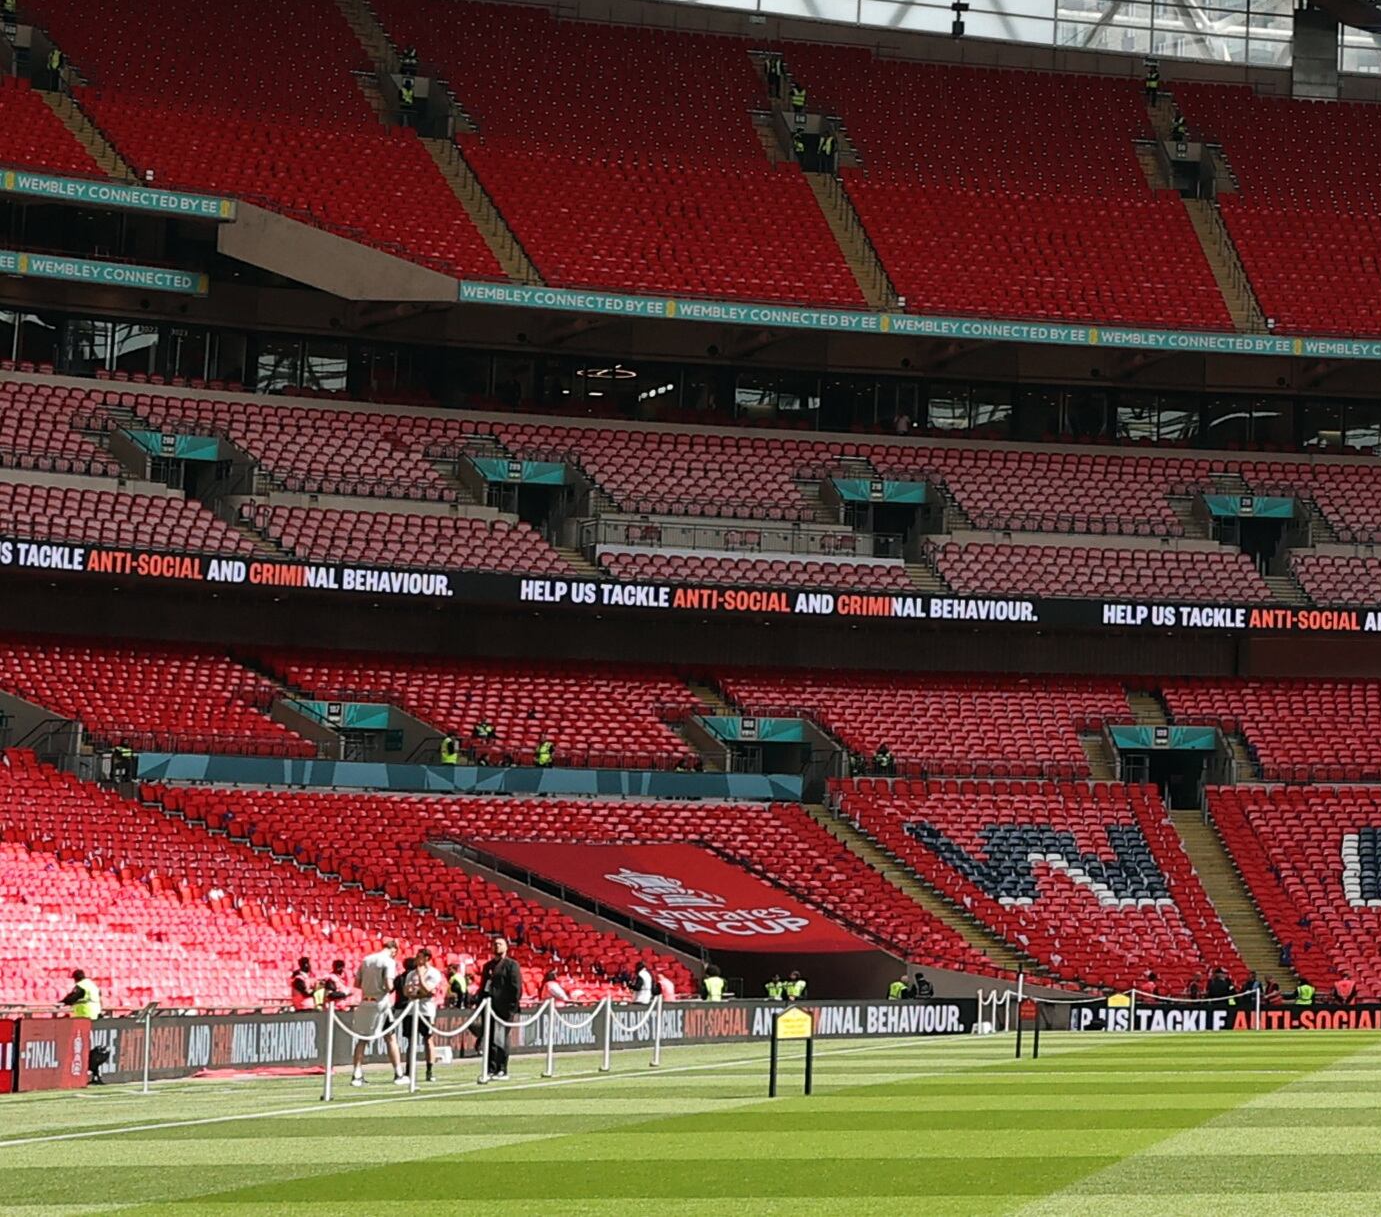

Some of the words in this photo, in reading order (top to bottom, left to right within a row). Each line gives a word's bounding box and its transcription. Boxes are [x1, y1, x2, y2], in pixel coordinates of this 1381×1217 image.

[19, 177, 85, 196] WEMBLEY
[89, 187, 177, 208] CONNECTED
[181, 198, 198, 211] BY
[202, 200, 217, 214] EE
[32, 260, 100, 278] WEMBLEY
[104, 267, 191, 287] CONNECTED
[463, 286, 531, 302] WEMBLEY
[535, 293, 623, 310] CONNECTED
[626, 300, 644, 312] BY
[647, 301, 662, 314] EE
[680, 304, 746, 320] WEMBLEY
[751, 309, 838, 326] CONNECTED
[841, 315, 858, 327] BY
[862, 317, 876, 329] EE
[893, 319, 958, 333] WEMBLEY
[962, 323, 1047, 339] CONNECTED
[1050, 329, 1067, 340] BY
[1071, 329, 1085, 341] EE
[17, 543, 84, 570] TACKLE
[88, 550, 202, 578] ANTI-SOCIAL
[207, 559, 245, 583] AND
[250, 562, 338, 589] CRIMINAL
[343, 569, 452, 596] BEHAVIOUR.
[521, 580, 567, 602] HELP
[572, 583, 596, 603] US
[601, 584, 669, 607] TACKLE
[674, 588, 790, 612] ANTI-SOCIAL
[795, 593, 833, 614] AND
[838, 595, 926, 618] CRIMINAL
[930, 598, 1037, 622] BEHAVIOUR.
[1103, 605, 1148, 624] HELP
[1152, 606, 1175, 626] US
[1180, 607, 1245, 628] TACKLE
[1250, 609, 1360, 630] ANTI-SOCIAL
[629, 904, 791, 923] Emirates
[652, 917, 720, 935] FA
[717, 917, 811, 936] CUP
[685, 1008, 748, 1037] ANTI-SOCIAL
[867, 1004, 963, 1034] BEHAVIOUR.
[1137, 1009, 1225, 1030] TACKLE
